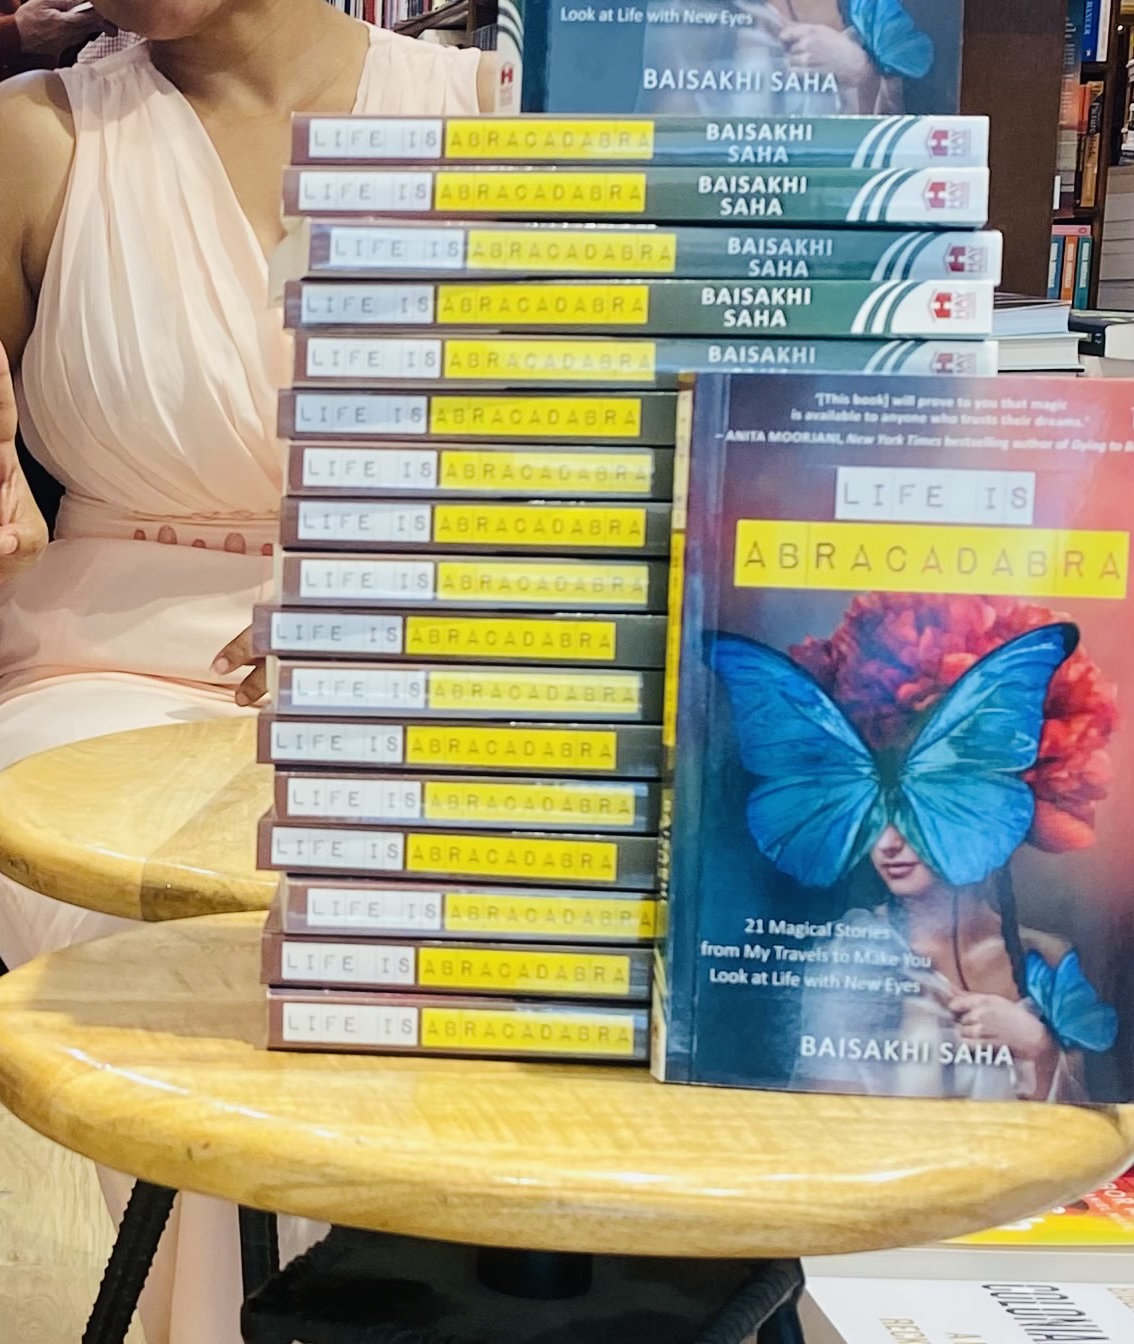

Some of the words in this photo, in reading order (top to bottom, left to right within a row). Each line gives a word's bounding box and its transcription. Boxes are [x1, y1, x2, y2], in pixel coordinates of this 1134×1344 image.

[560, 6, 596, 23] Look
[598, 9, 613, 23] at
[617, 7, 643, 23] Life
[647, 8, 680, 24] with
[683, 9, 717, 24] New
[720, 10, 754, 28] Eyes
[643, 68, 761, 91] BAISAKHI
[770, 70, 839, 93] SAHA
[314, 130, 383, 148] LIFE
[407, 131, 438, 149] IS
[450, 130, 650, 148] ABRACADABRA
[706, 123, 812, 142] BAISAKHI
[728, 145, 789, 163] SAHA
[304, 184, 372, 201] LIFE
[398, 184, 427, 201] IS
[440, 183, 642, 201] ABRACADABRA
[698, 175, 807, 194] BAISAKHI
[720, 198, 784, 216] SAHA
[335, 239, 404, 257] LIFE
[431, 240, 460, 257] IS
[472, 244, 672, 262] ABRACADABRA
[727, 238, 833, 256] BAISAKHI
[748, 259, 809, 278] SAHA
[306, 296, 374, 313] LIFE
[401, 296, 430, 313] IS
[442, 297, 644, 314] ABRACADABRA
[701, 287, 811, 306] BAISAKHI
[723, 309, 787, 327] SAHA
[708, 346, 816, 364] BAISAKHI
[842, 481, 944, 508] LIFE
[985, 486, 1029, 510] IS
[743, 539, 1121, 581] ABRACADABRA
[743, 918, 764, 935] 21
[768, 920, 832, 938] Magical
[834, 922, 890, 939] Stories
[701, 941, 740, 958] from
[743, 944, 770, 962] My
[774, 944, 828, 963] Travels
[832, 948, 849, 963] to
[854, 949, 899, 967] Make
[904, 951, 932, 968] You
[709, 968, 748, 985] Look
[751, 970, 768, 985] at
[771, 970, 801, 987] Life
[804, 972, 841, 989] with
[845, 974, 882, 992] New
[885, 976, 921, 996] Eyes
[287, 1015, 356, 1033] LIFE
[383, 1016, 413, 1034] IS
[427, 1021, 629, 1042] ABRACADABRA
[800, 1035, 929, 1062] BAISAKHI
[939, 1042, 1014, 1066] SAHA
